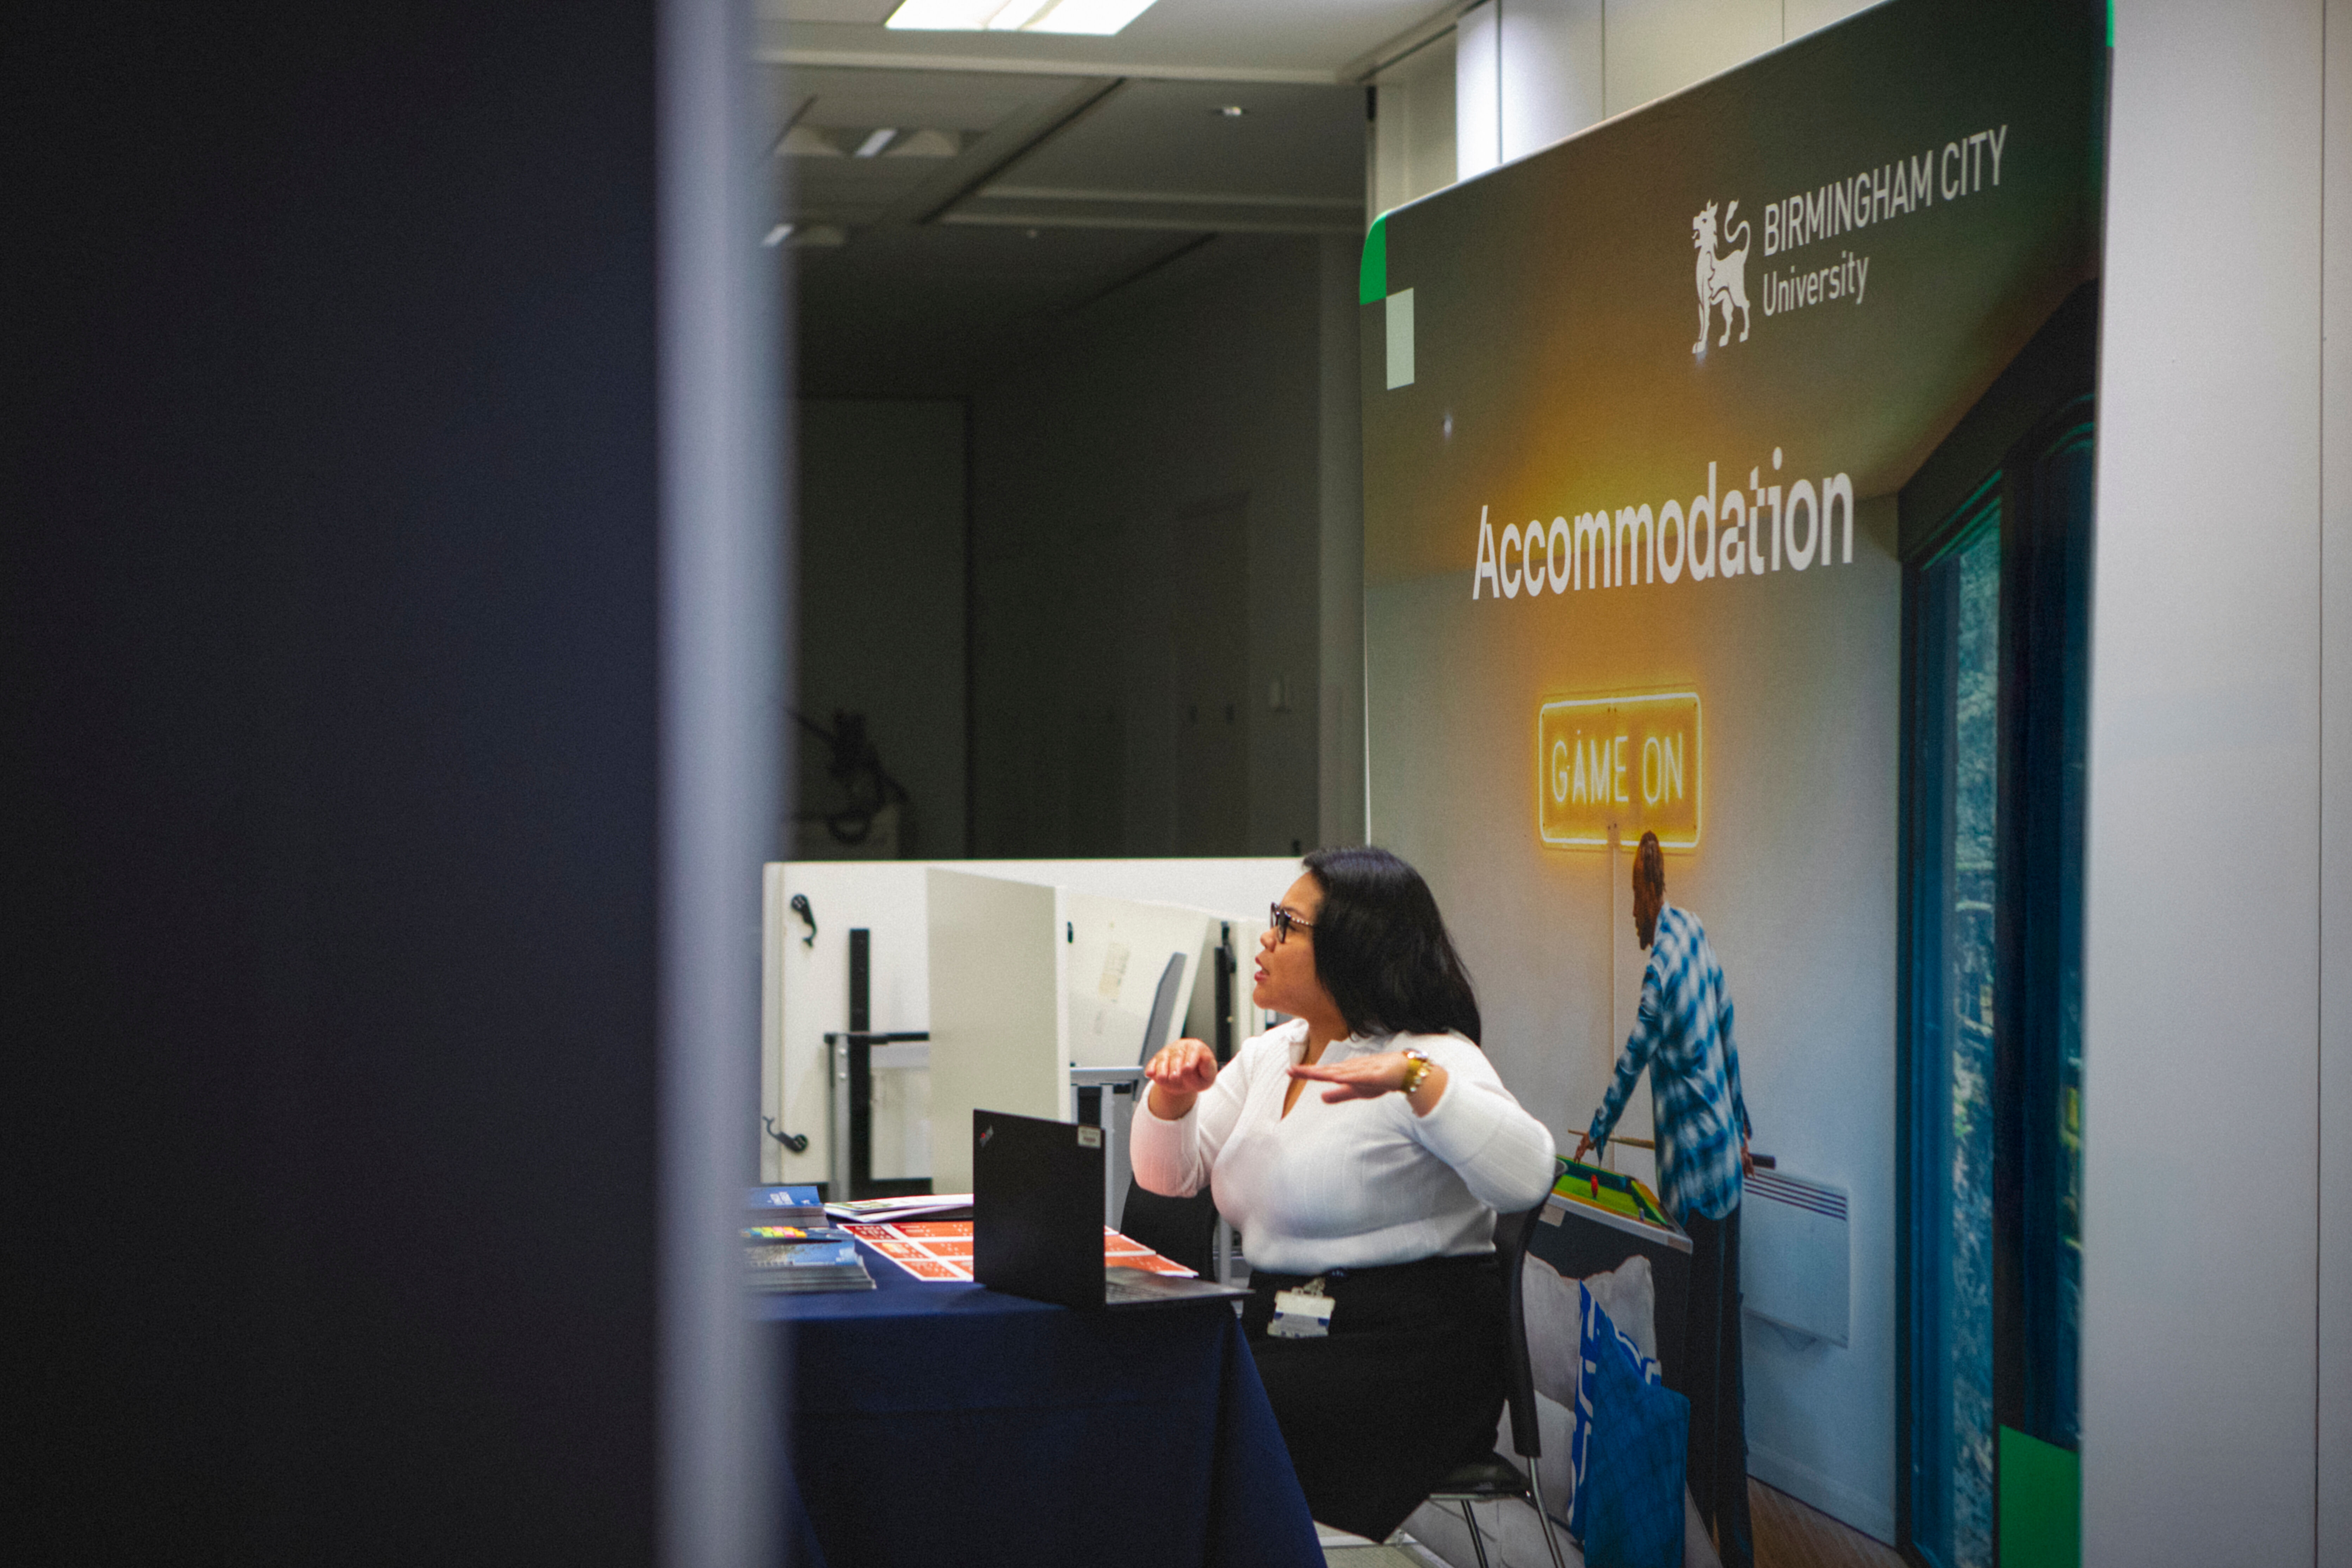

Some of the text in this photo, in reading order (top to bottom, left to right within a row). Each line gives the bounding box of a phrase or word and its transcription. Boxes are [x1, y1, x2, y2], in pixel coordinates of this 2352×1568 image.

[1764, 124, 2008, 256] BIRMINGHAM CITY
[1763, 250, 1869, 316] University
[1473, 446, 1853, 600] Accommodation
[1552, 732, 1683, 805] GAME ON
